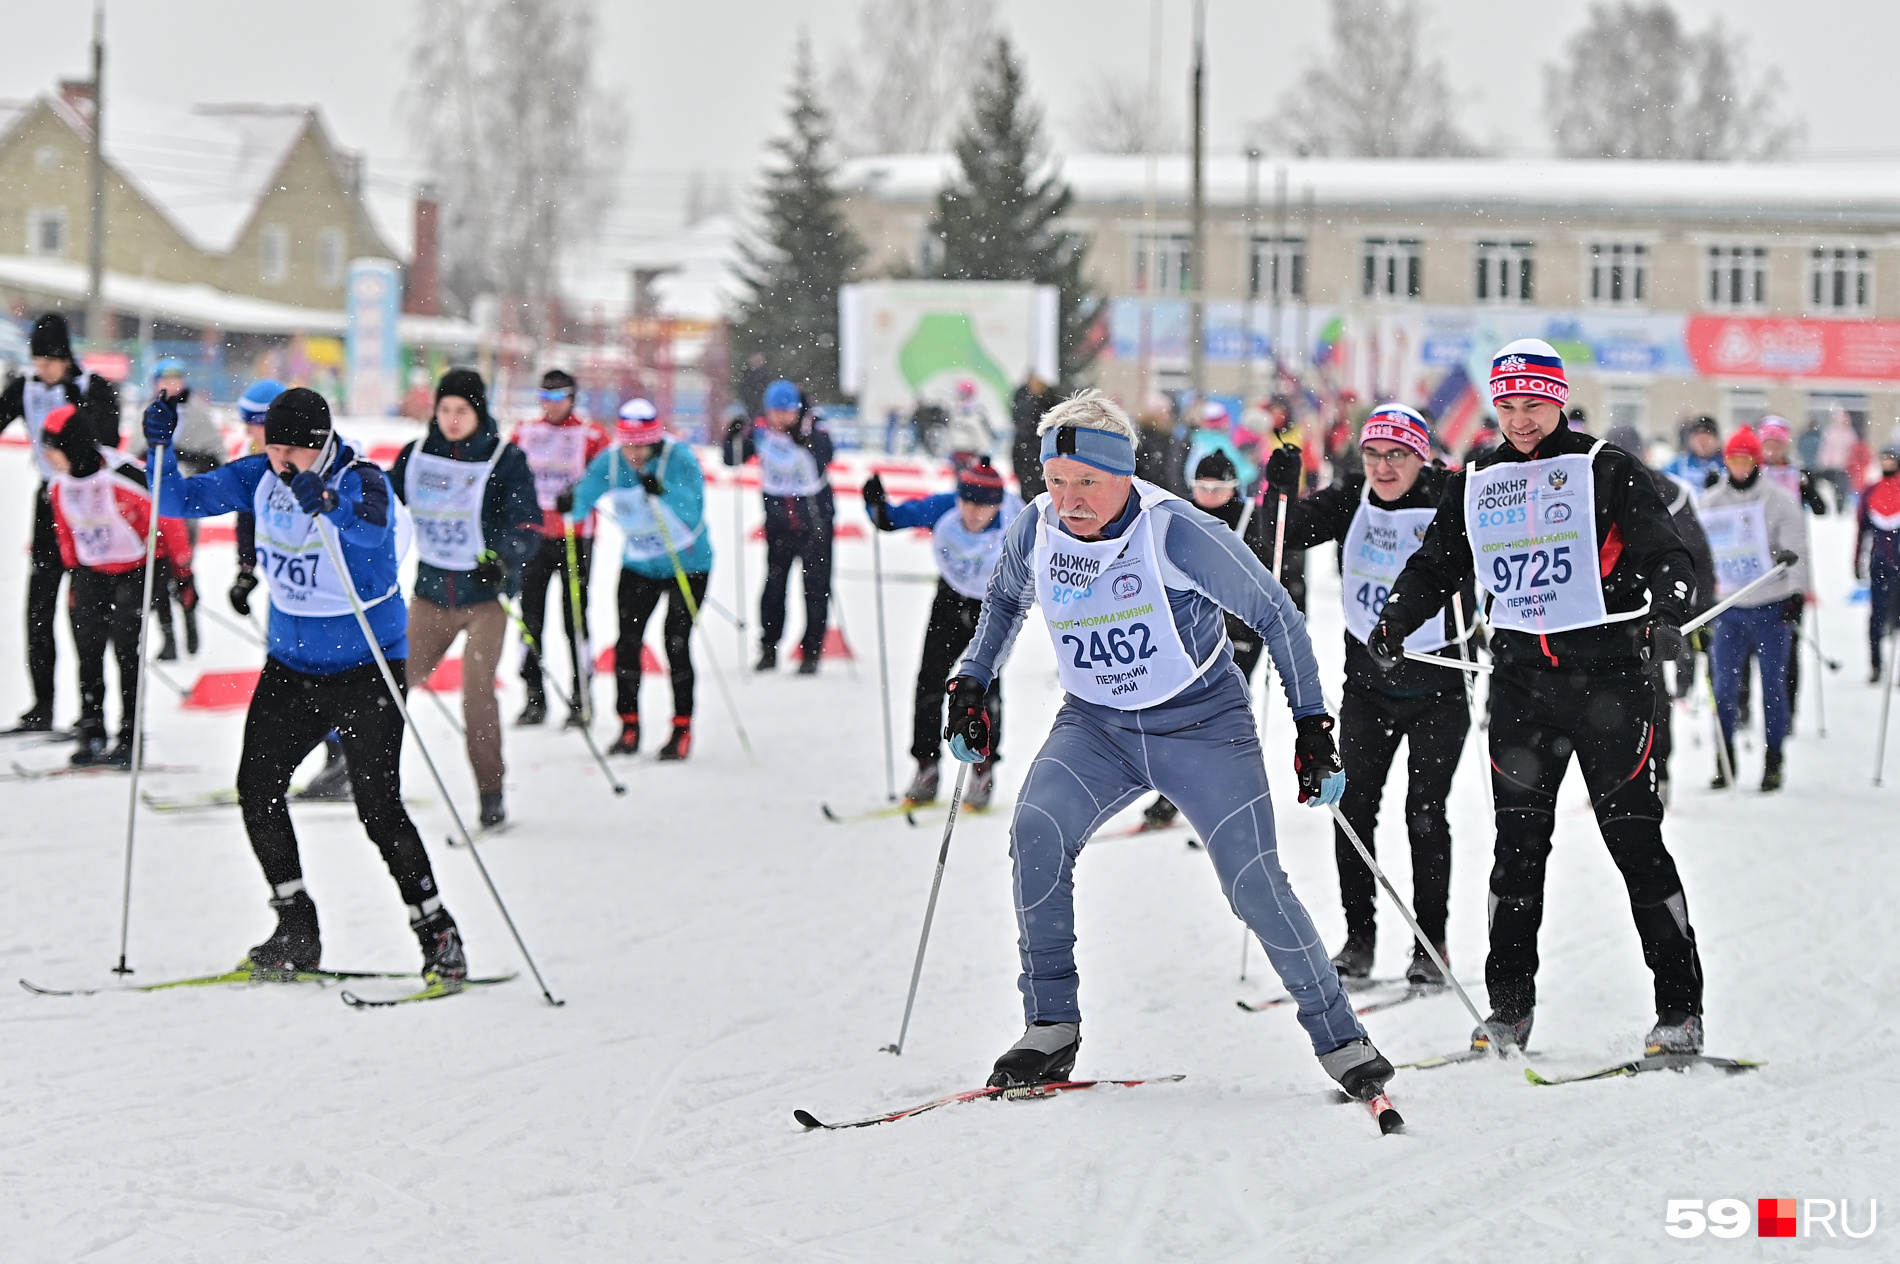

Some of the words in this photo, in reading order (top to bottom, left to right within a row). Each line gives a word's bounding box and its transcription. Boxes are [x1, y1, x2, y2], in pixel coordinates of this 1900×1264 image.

[1490, 380, 1507, 396] НЯ
[1477, 479, 1528, 498] ЛЫЖНЯ
[1477, 491, 1527, 510] РОССИИ
[1478, 507, 1527, 528] 2023
[1481, 542, 1506, 553] СПОРТ
[1049, 552, 1101, 574] ЛЫЖНЯ
[1493, 546, 1573, 593] 9725
[1507, 591, 1558, 608] ПЕРМСКИЙ
[1079, 612, 1116, 628] НОРМА
[1115, 603, 1154, 621] ЖИЗНИ
[1521, 606, 1546, 619] КРАЙ
[1061, 622, 1158, 669] 2462
[1095, 664, 1148, 685] ПЕРМСКИЙ
[1111, 681, 1139, 696] КРАЙ
[1002, 1086, 1031, 1099] ATOMIC
